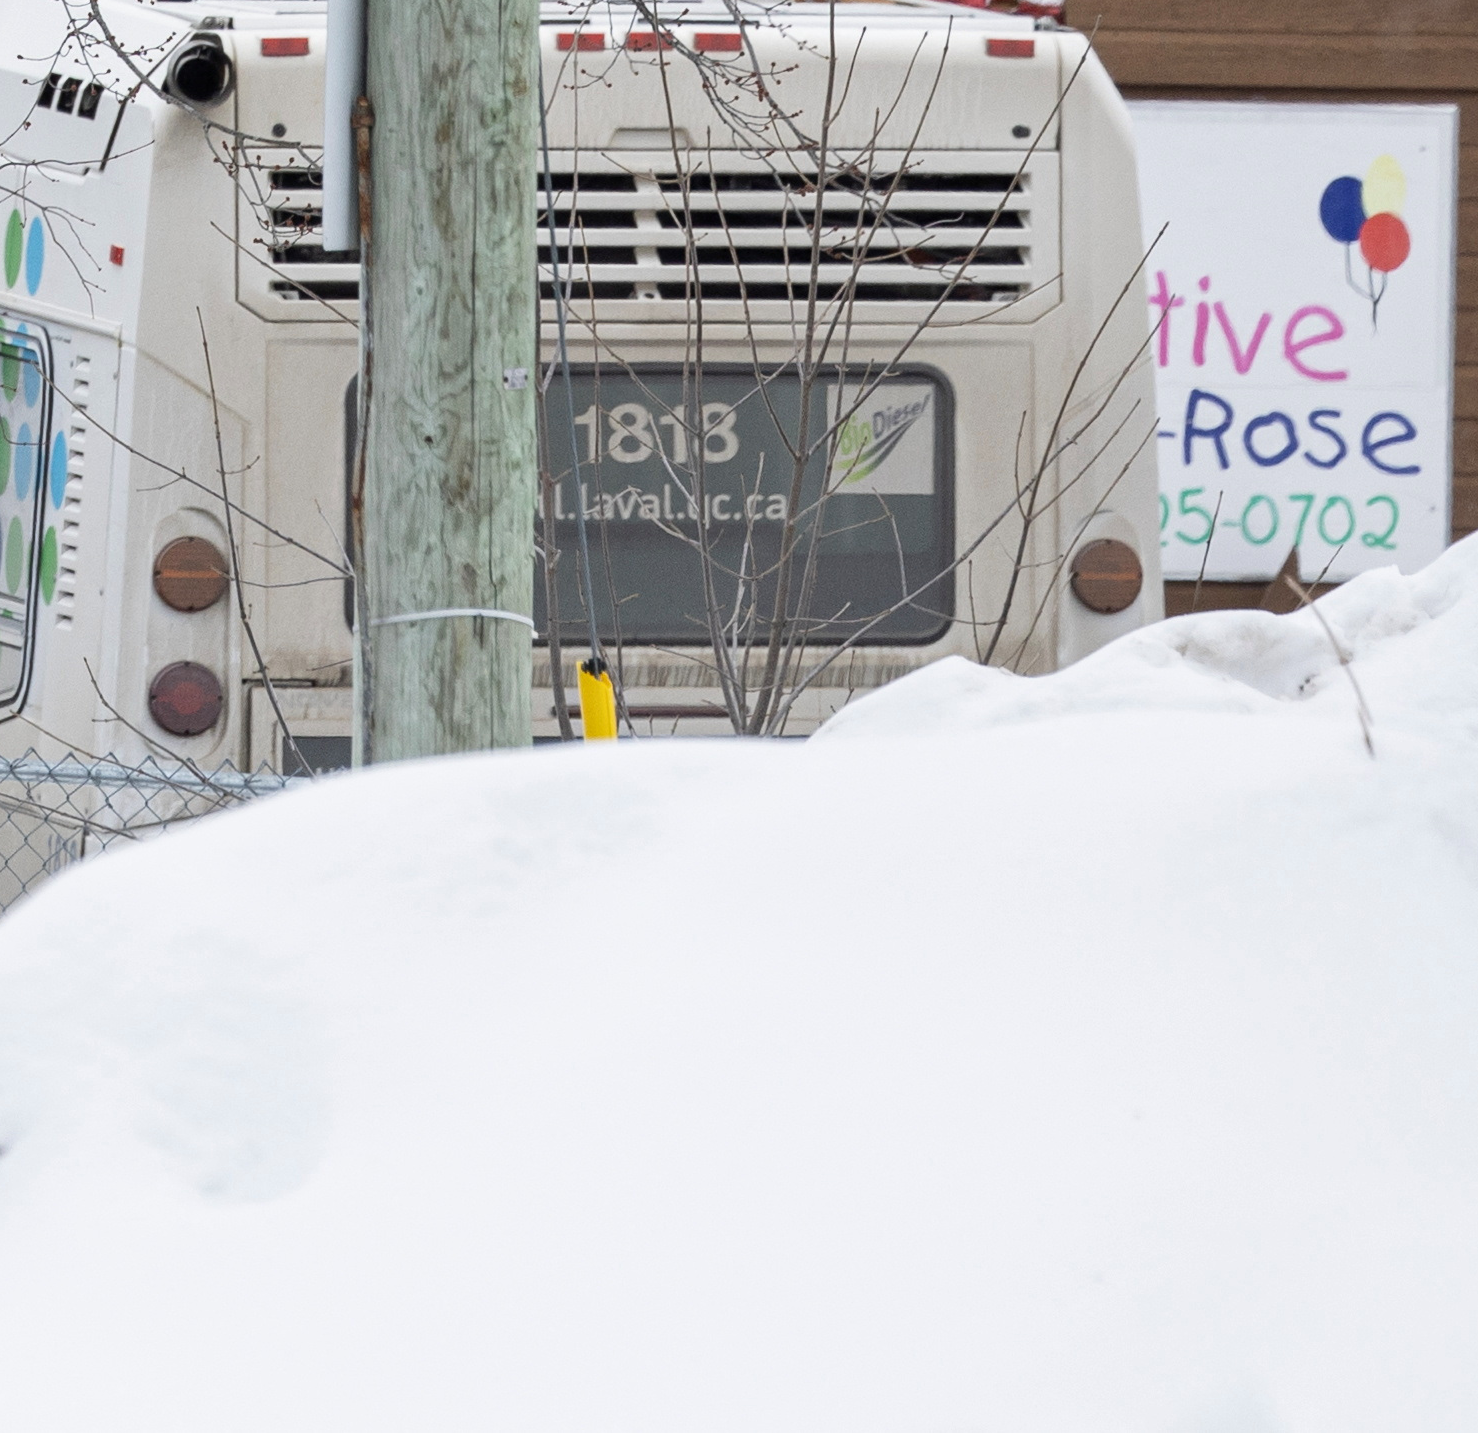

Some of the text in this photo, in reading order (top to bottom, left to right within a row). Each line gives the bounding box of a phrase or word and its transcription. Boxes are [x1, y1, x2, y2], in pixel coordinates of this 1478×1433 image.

[1148, 269, 1349, 381] tive
[574, 402, 740, 464] 1818
[1157, 388, 1422, 475] -Rose
